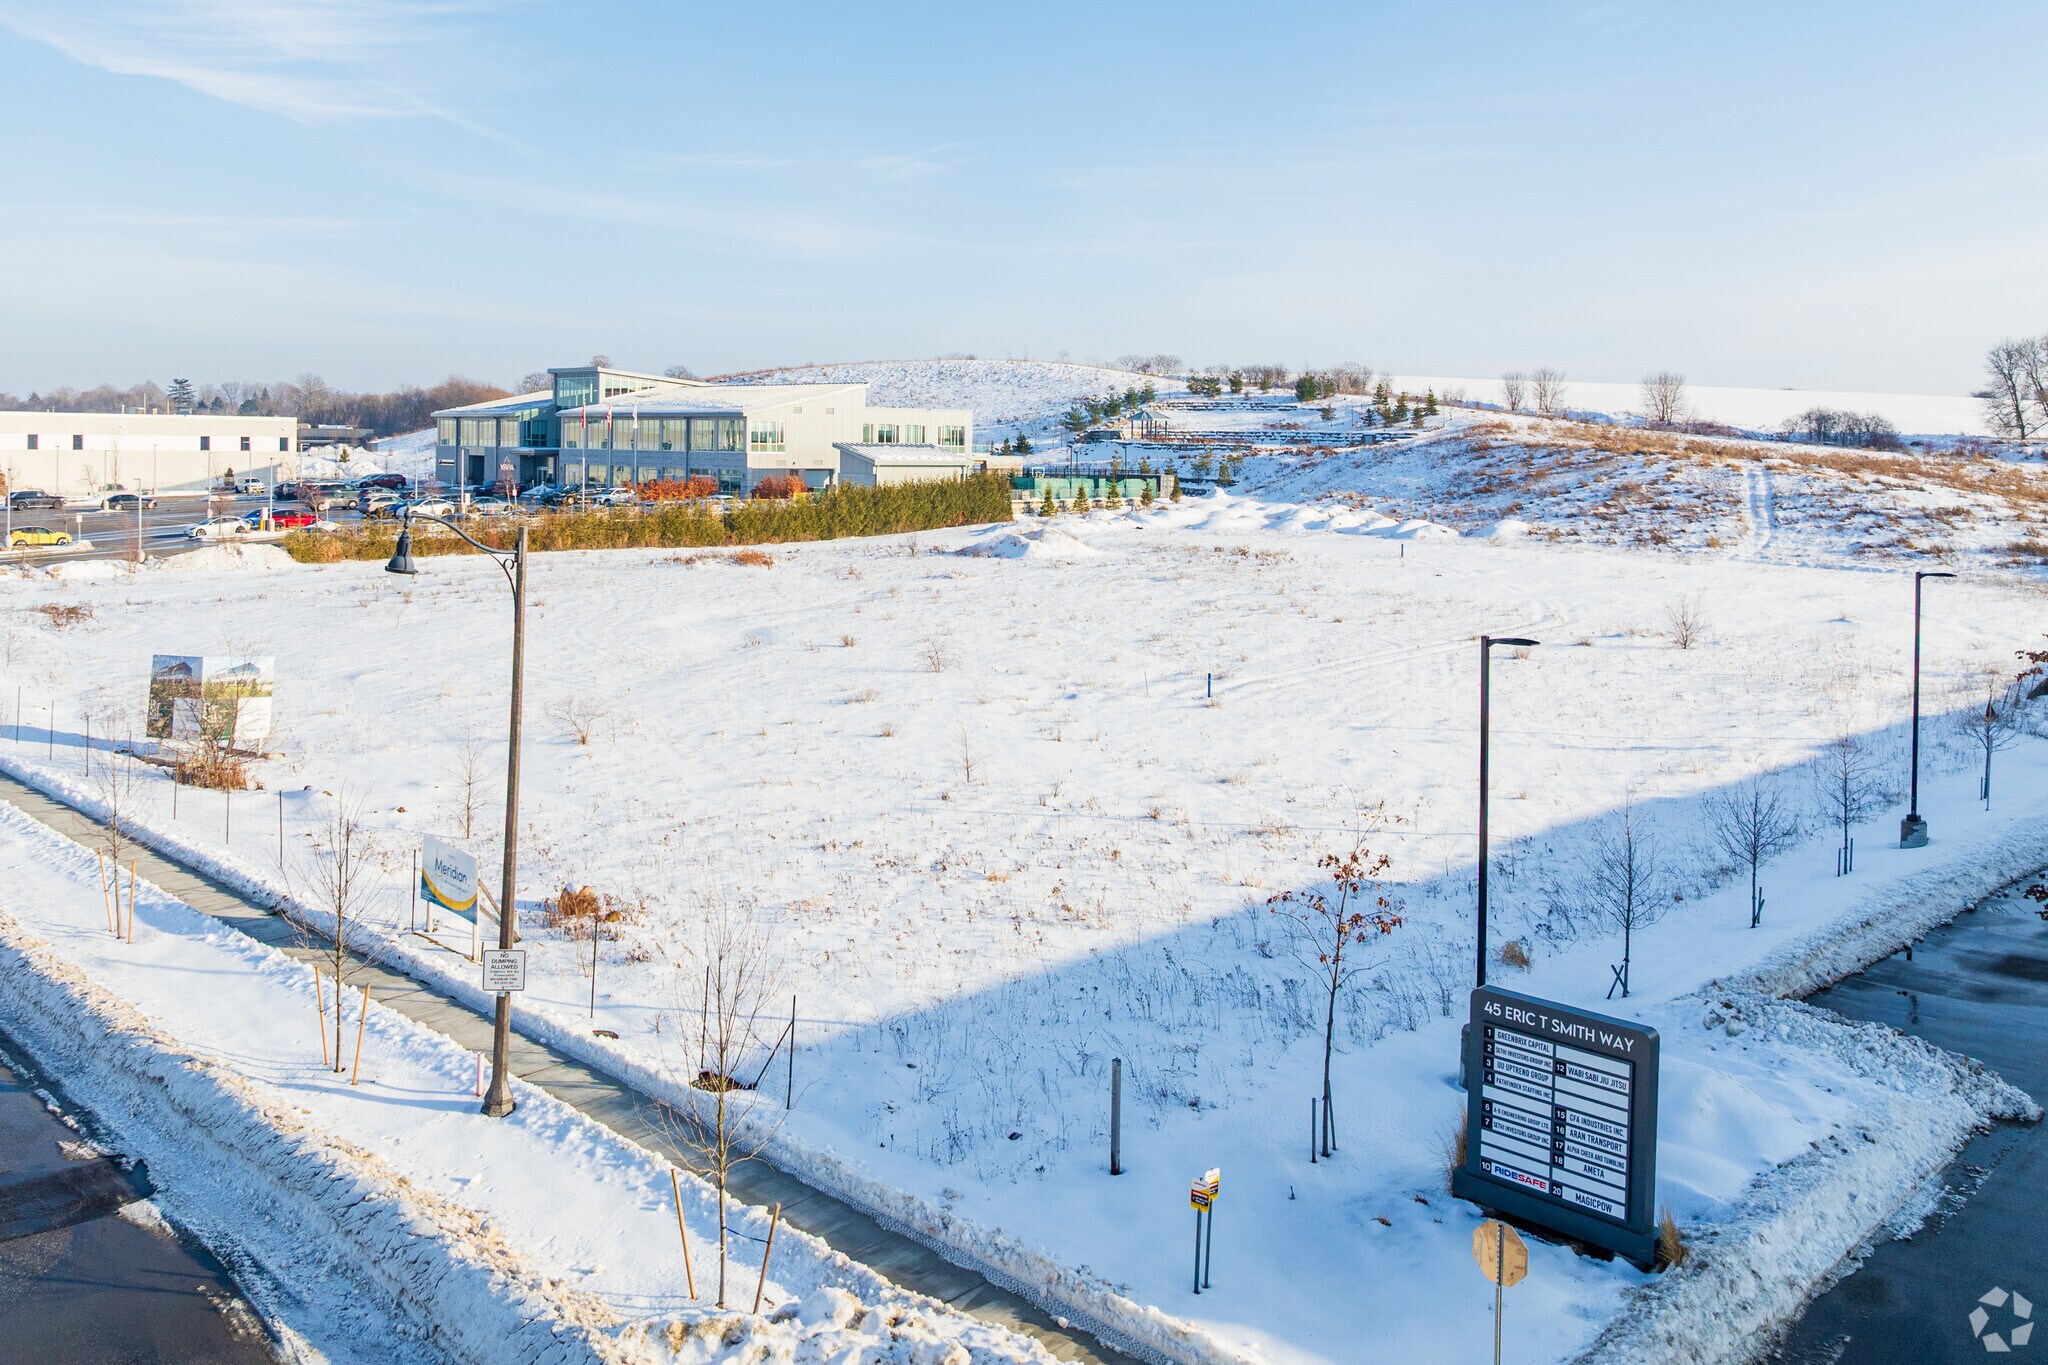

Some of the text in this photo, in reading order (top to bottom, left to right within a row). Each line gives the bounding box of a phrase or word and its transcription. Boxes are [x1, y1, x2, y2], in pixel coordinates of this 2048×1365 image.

[434, 857, 467, 884] Meridian
[1484, 1001, 1634, 1052] 45 ERIC T SMITH WAY
[1487, 1044, 1492, 1052] 2
[1497, 1031, 1550, 1053] GREENBRIX CAPITAL
[1508, 1050, 1529, 1062] INVESTORS
[1530, 1056, 1543, 1065] GROUP
[1506, 1064, 1530, 1077] UPTREND
[1530, 1071, 1548, 1082] GROUP
[1556, 1064, 1565, 1073] 12
[1496, 1077, 1522, 1091] PATHFINDER
[1522, 1085, 1542, 1096] STAFFING
[1567, 1067, 1627, 1090] WABI SABI JIU JITSU
[1502, 1109, 1526, 1122] ENGINEERING
[1527, 1116, 1540, 1125] GROUP
[1556, 1110, 1565, 1119] 15
[1505, 1124, 1526, 1138] INVESTORS
[1527, 1132, 1541, 1142] GROUP
[1556, 1126, 1565, 1135] 16
[1570, 1114, 1580, 1124] CFA
[1581, 1117, 1612, 1134] INDUSTRIES
[1555, 1141, 1564, 1150] 17
[1570, 1129, 1622, 1152] ARAN TRANSPORT
[1554, 1156, 1563, 1164] 18
[1566, 1144, 1625, 1169] ALPHA CHEER AND TUMBLING
[1482, 1161, 1491, 1171] 10
[1583, 1164, 1604, 1178] AMETA
[1494, 1166, 1546, 1189] RIDESAFE
[1552, 1187, 1562, 1196] 20
[1575, 1193, 1612, 1214] MAGICPOW
